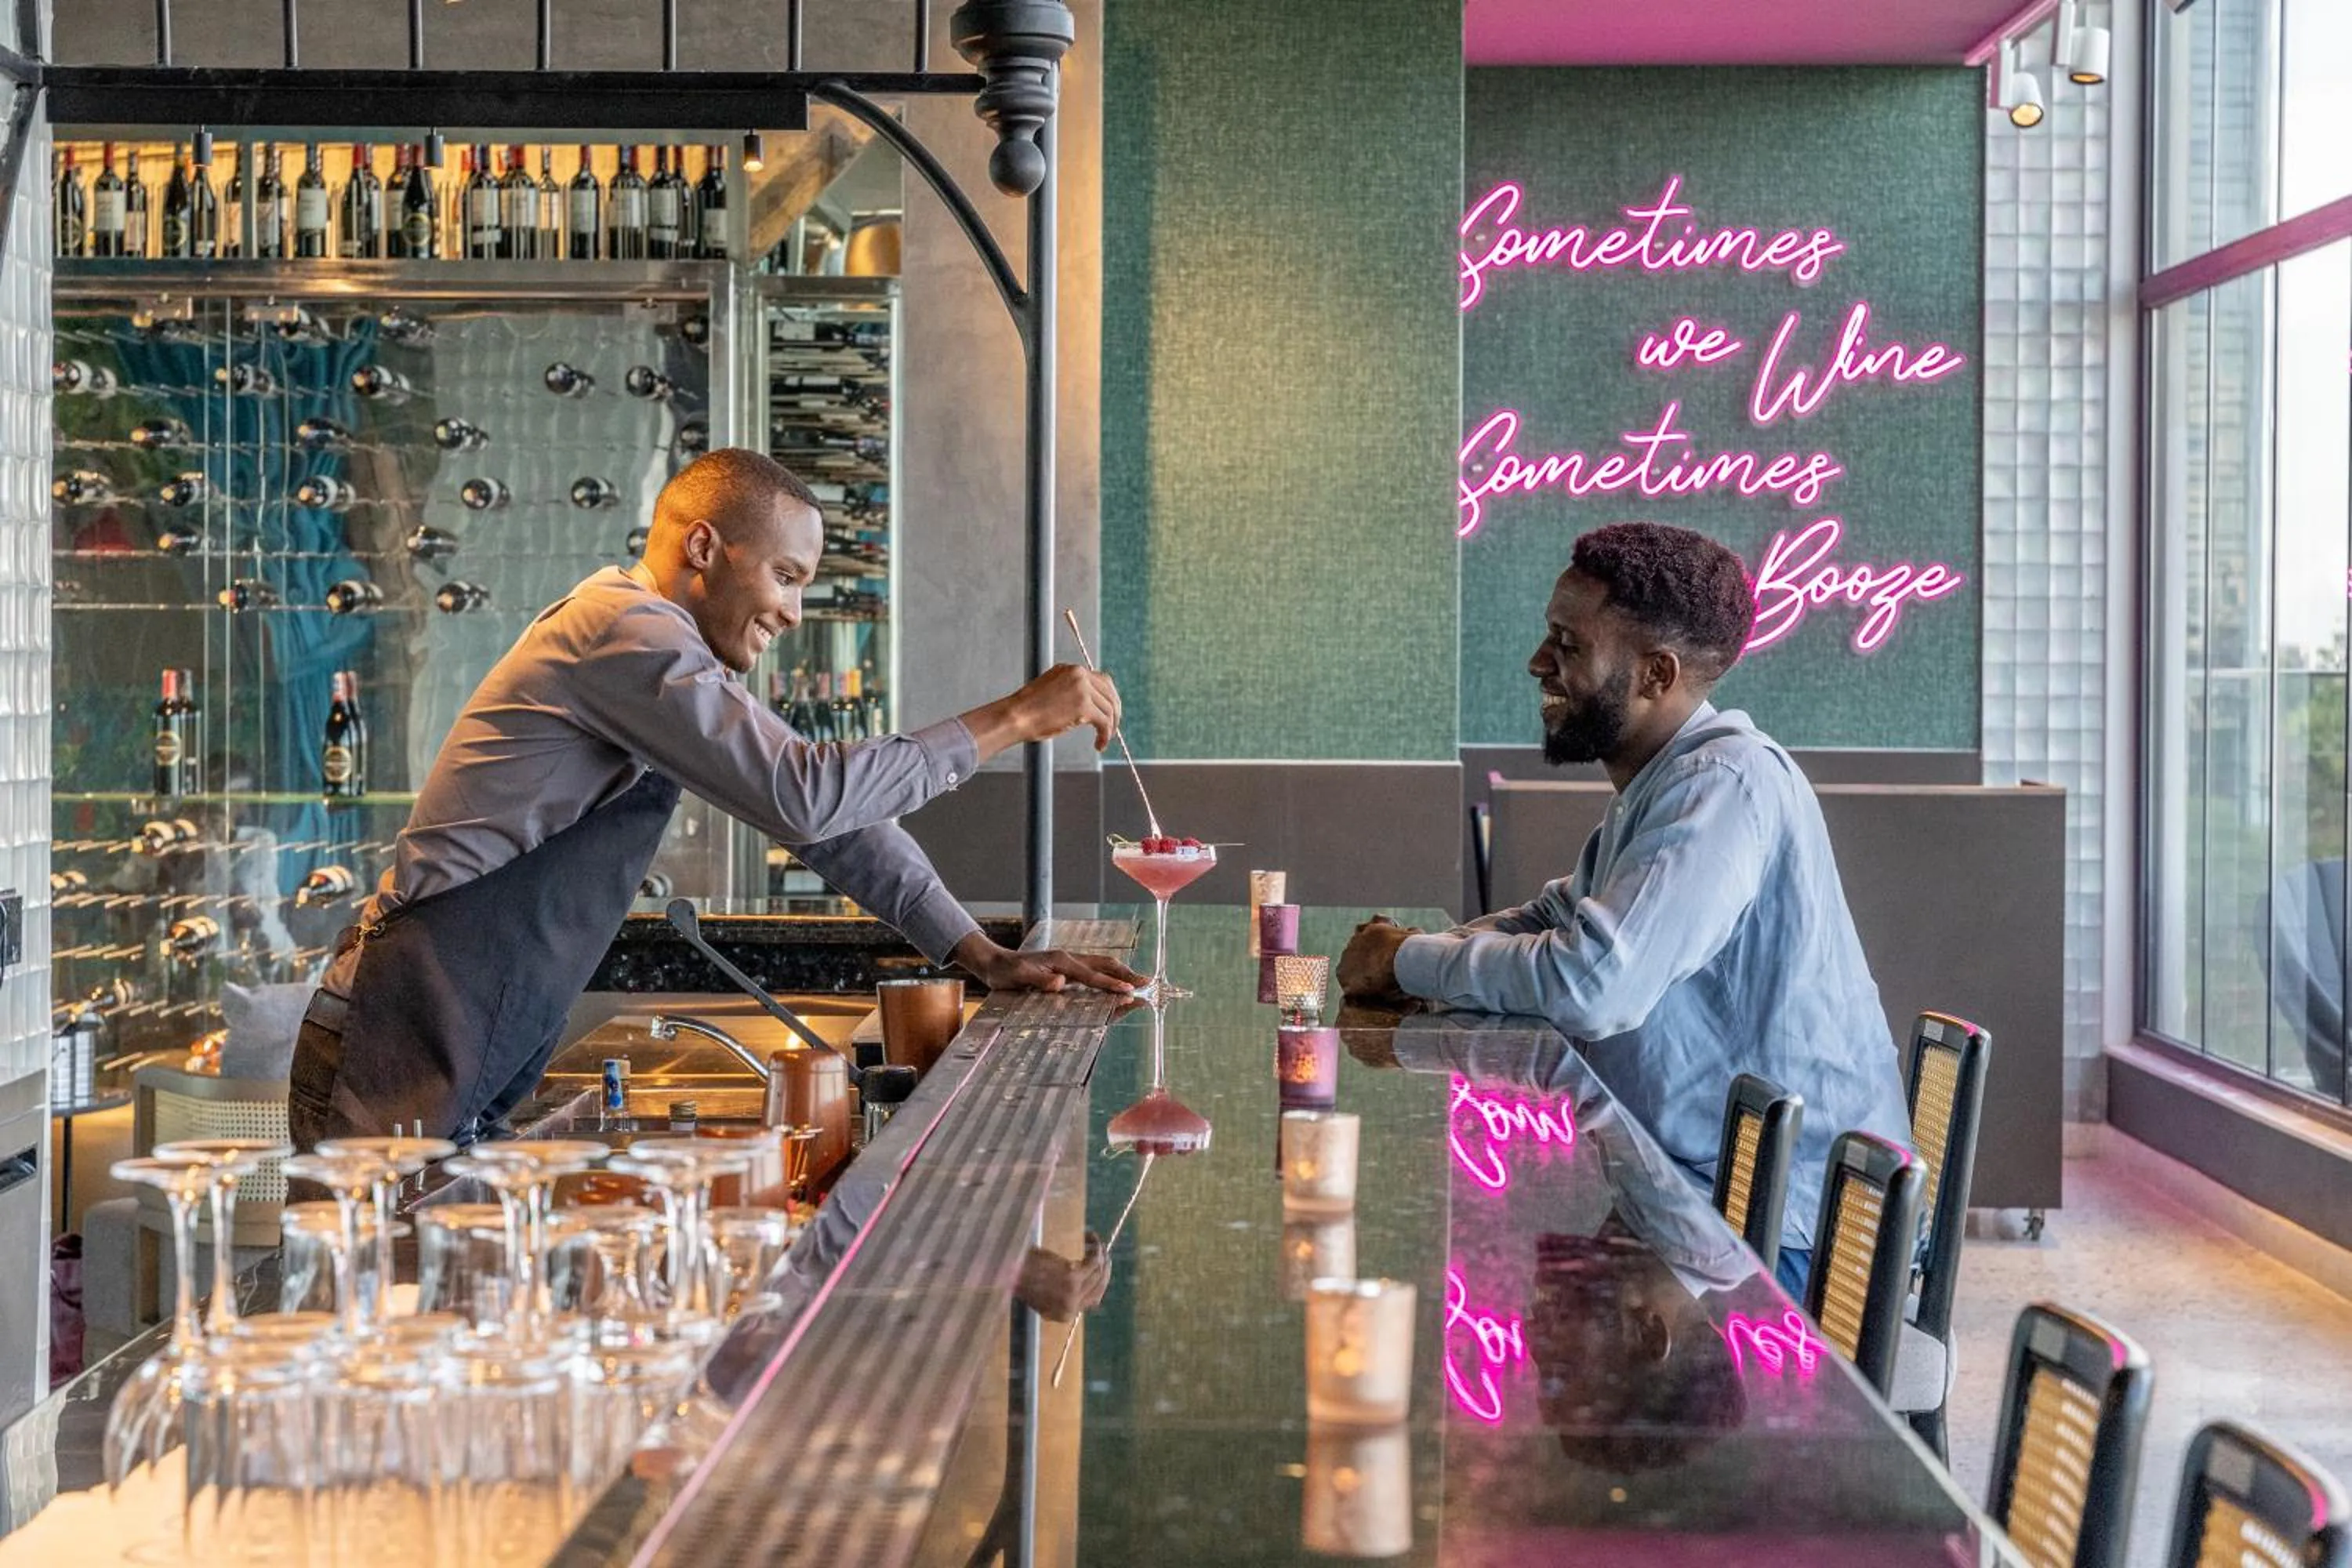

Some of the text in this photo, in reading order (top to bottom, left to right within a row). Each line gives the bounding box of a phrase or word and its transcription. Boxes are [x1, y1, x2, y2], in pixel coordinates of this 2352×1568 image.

[1460, 175, 1846, 309] Sometimes
[1637, 302, 1963, 423] we Wine
[1457, 401, 1842, 539] Sometimes
[1744, 518, 1962, 651] Booze
